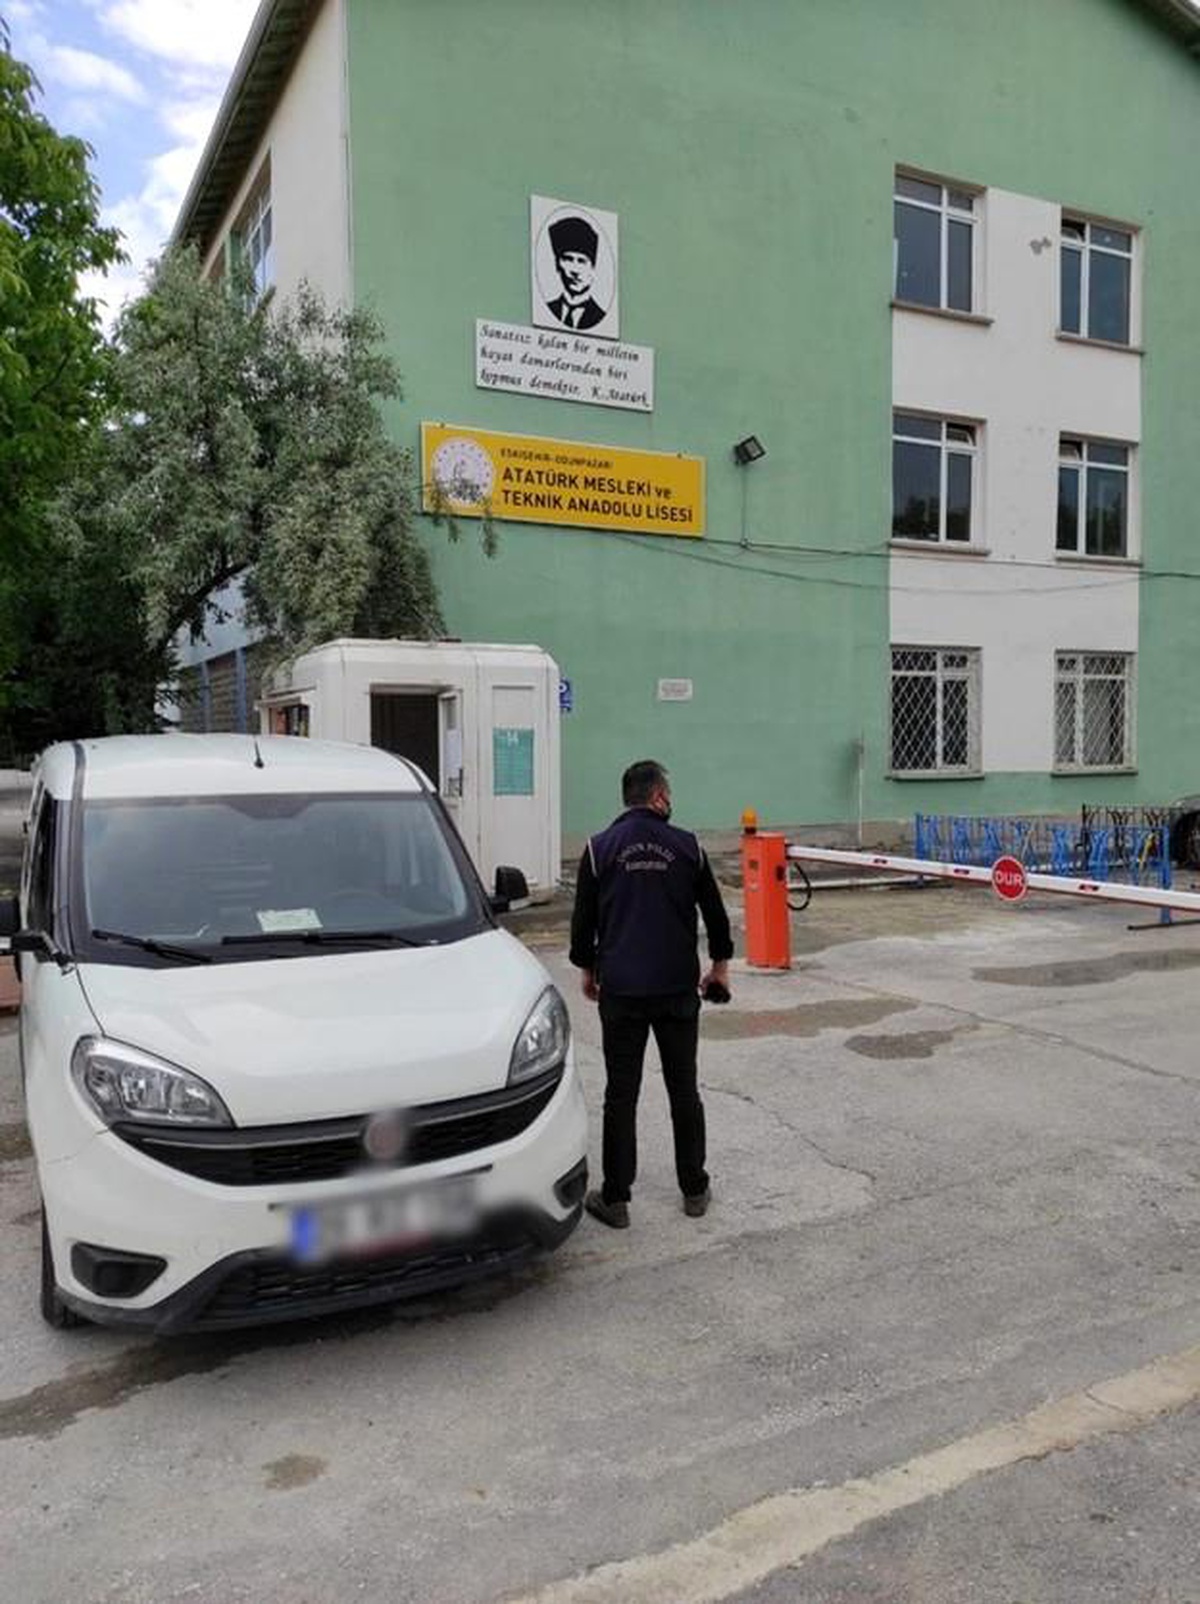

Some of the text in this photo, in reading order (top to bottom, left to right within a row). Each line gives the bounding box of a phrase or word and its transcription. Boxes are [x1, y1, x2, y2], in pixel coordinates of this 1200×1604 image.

[502, 466, 579, 489] ATATÜRK
[654, 486, 672, 500] ve
[567, 496, 642, 518] ANADOLU
[995, 870, 1023, 887] DUR
